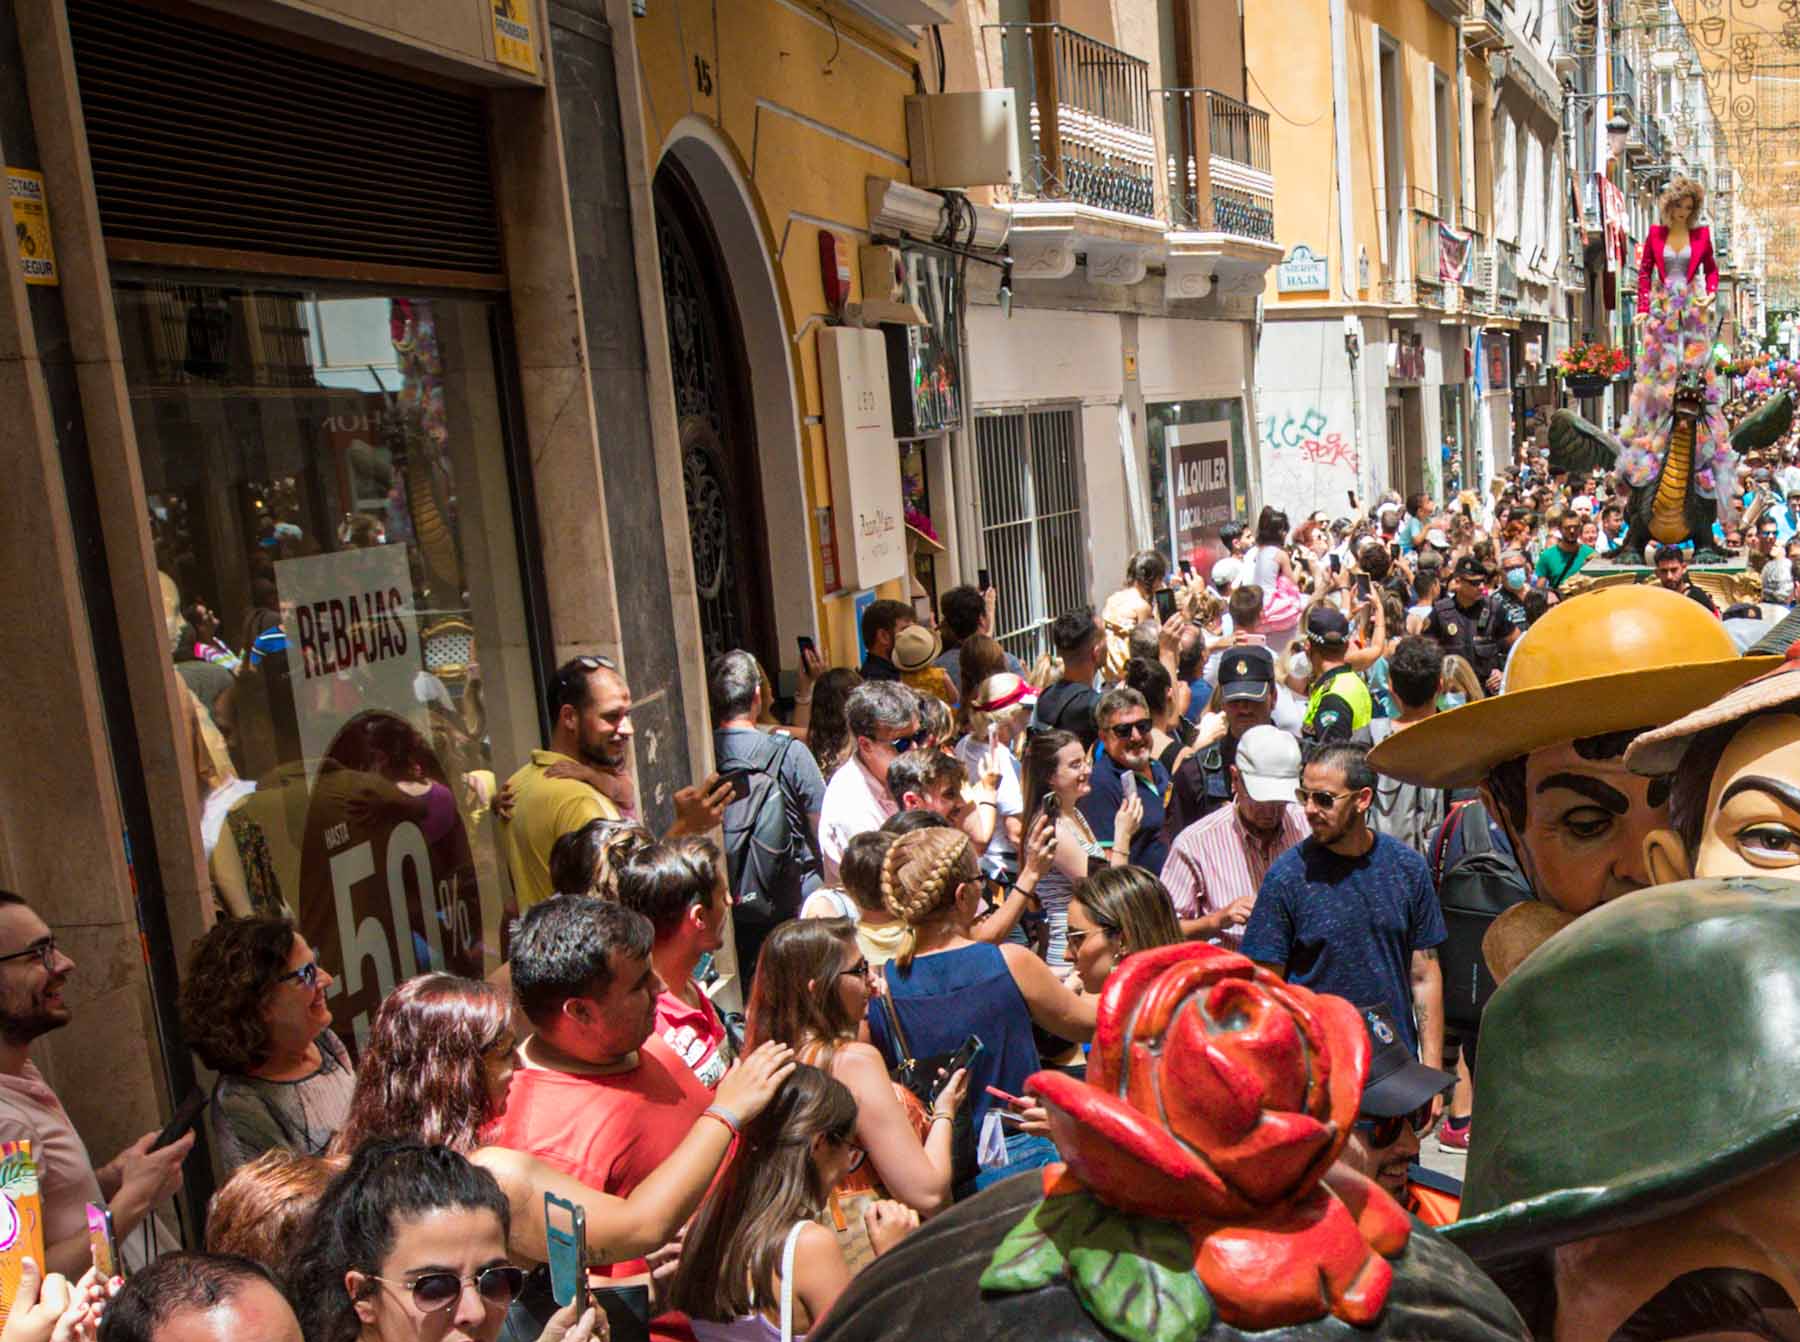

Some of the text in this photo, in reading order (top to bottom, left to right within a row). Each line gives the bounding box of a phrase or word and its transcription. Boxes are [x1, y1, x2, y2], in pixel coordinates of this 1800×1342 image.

[693, 54, 712, 97] 15
[1177, 457, 1227, 497] ALQUILER
[296, 586, 408, 679] REBAJAS
[324, 822, 351, 850] HASTA
